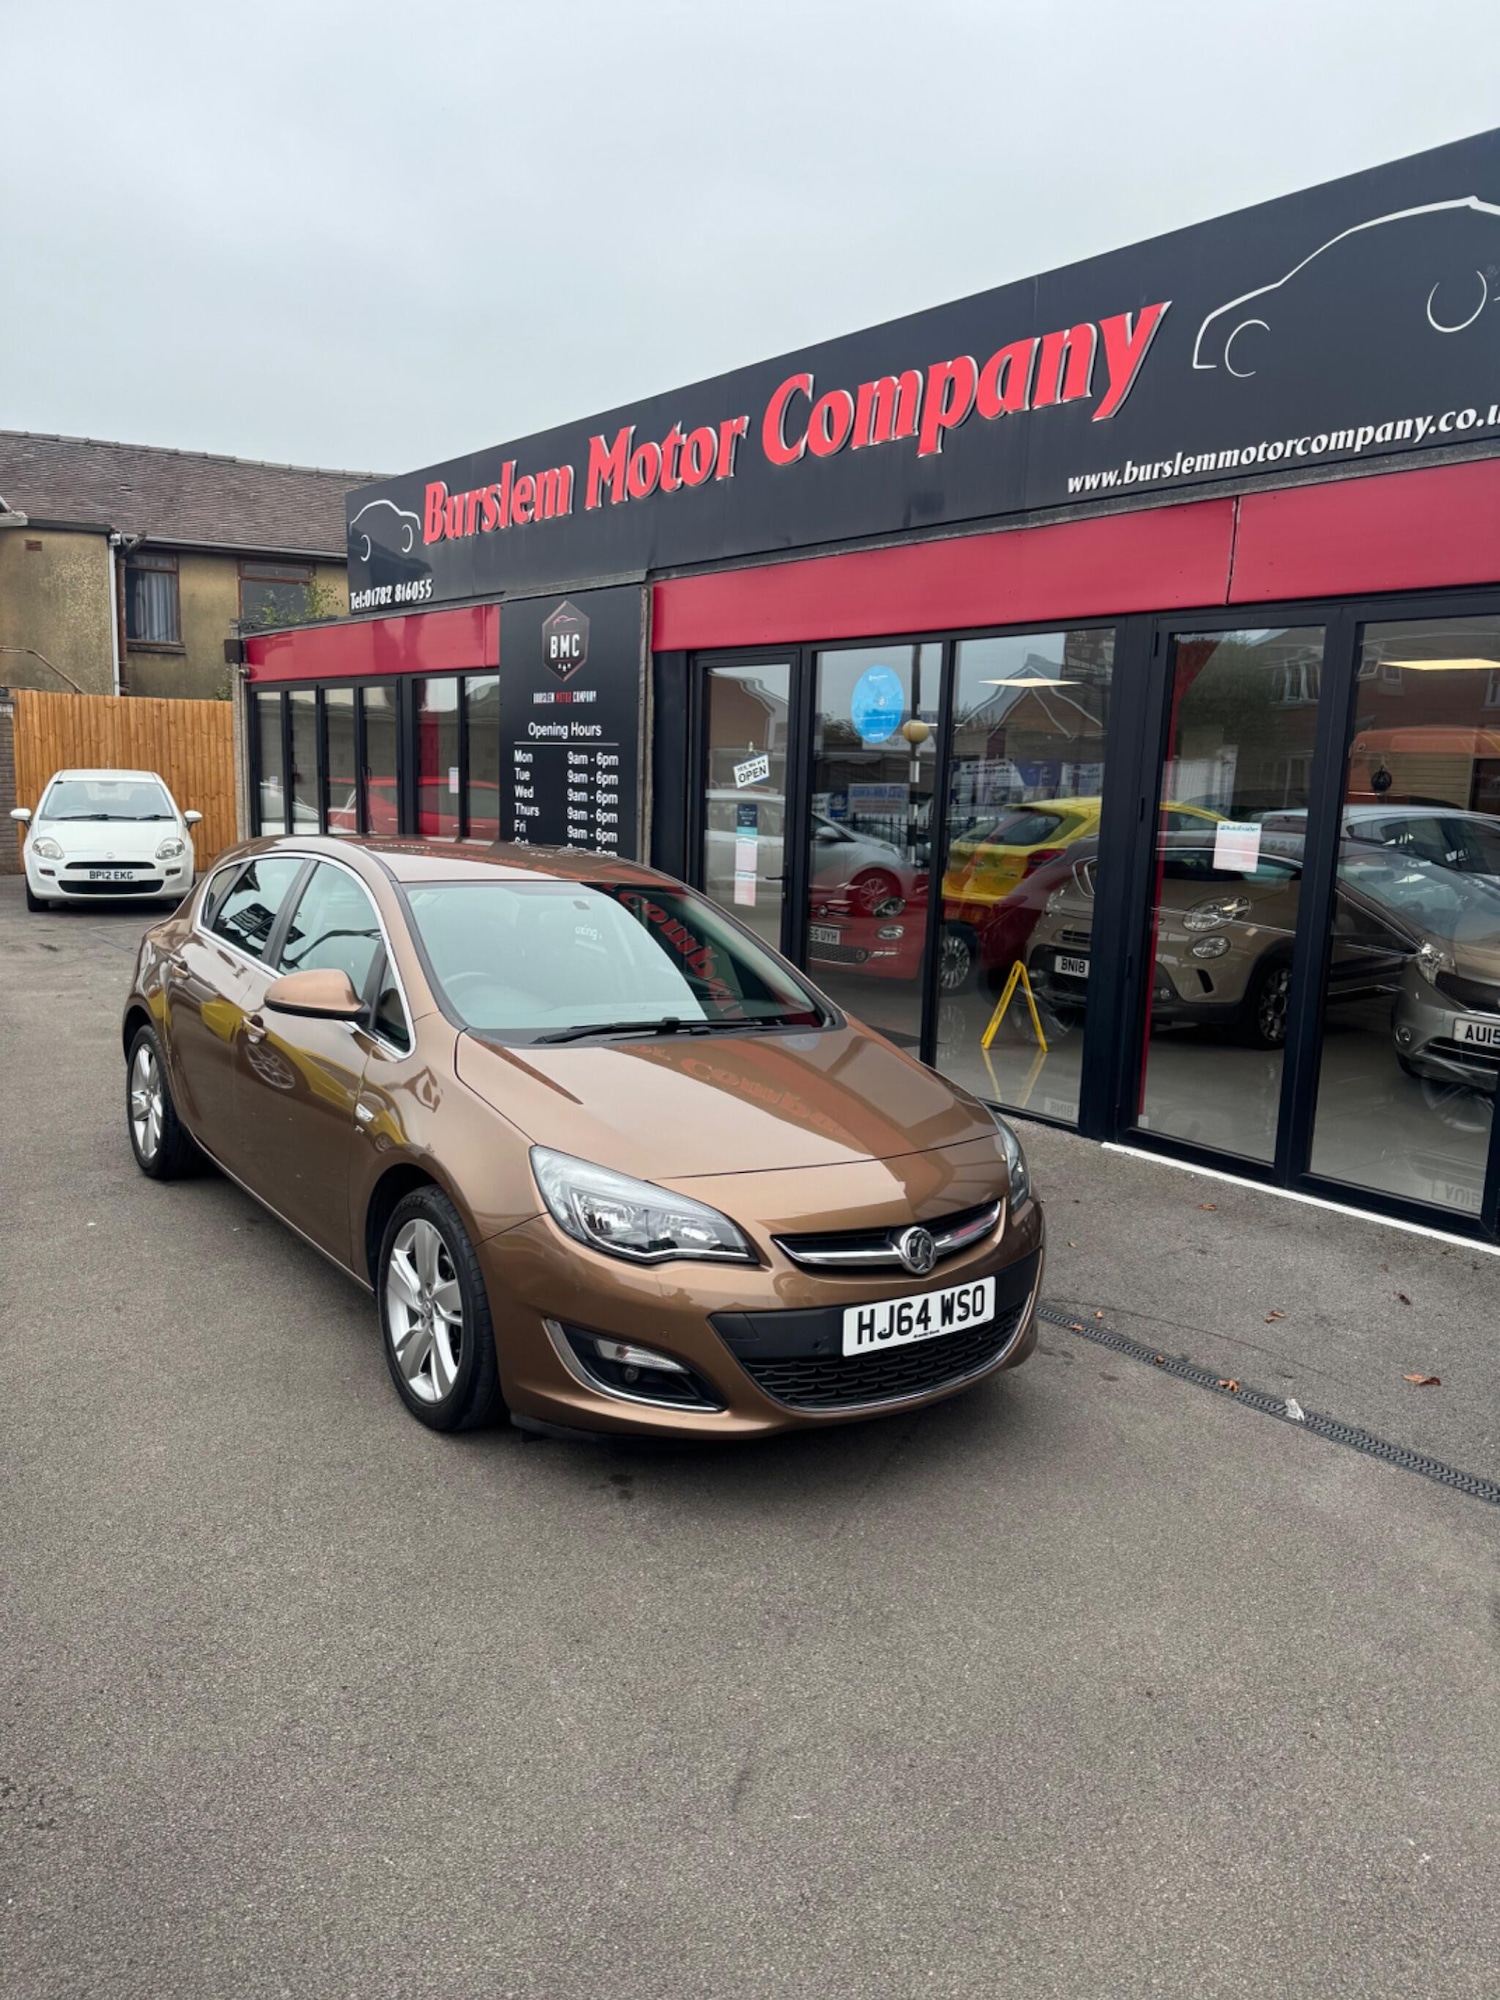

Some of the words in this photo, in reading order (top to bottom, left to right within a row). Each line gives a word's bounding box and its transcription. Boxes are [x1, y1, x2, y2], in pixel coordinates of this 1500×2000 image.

[423, 459, 576, 546] Burslem
[585, 415, 749, 511] Motor
[762, 300, 1171, 466] Company
[350, 585, 393, 610] Tel:01782
[394, 579, 432, 602] 816055
[550, 634, 580, 659] BMC
[528, 722, 568, 739] Opening
[570, 722, 602, 737] Hours
[514, 750, 533, 763] Mon
[567, 751, 588, 765] 9am
[596, 752, 619, 768] 6pm
[514, 768, 530, 781] Tue
[567, 770, 588, 783] 9am
[596, 771, 618, 788] 6pm
[738, 764, 766, 783] OPEN
[514, 785, 534, 798] Wed
[567, 788, 588, 802] 9am
[596, 790, 618, 806] 6pm
[514, 802, 540, 817] Thurs
[567, 806, 588, 820] 9am
[596, 809, 618, 825] 6pm
[514, 820, 526, 833] Fri
[567, 825, 588, 839] 9am
[596, 828, 618, 844] 6pm
[89, 871, 112, 880] BP12
[113, 871, 134, 880] EKG
[820, 929, 838, 943] UYH
[1061, 958, 1086, 974] BN18
[856, 1298, 932, 1345] HJ64
[940, 1284, 986, 1327] WSO
